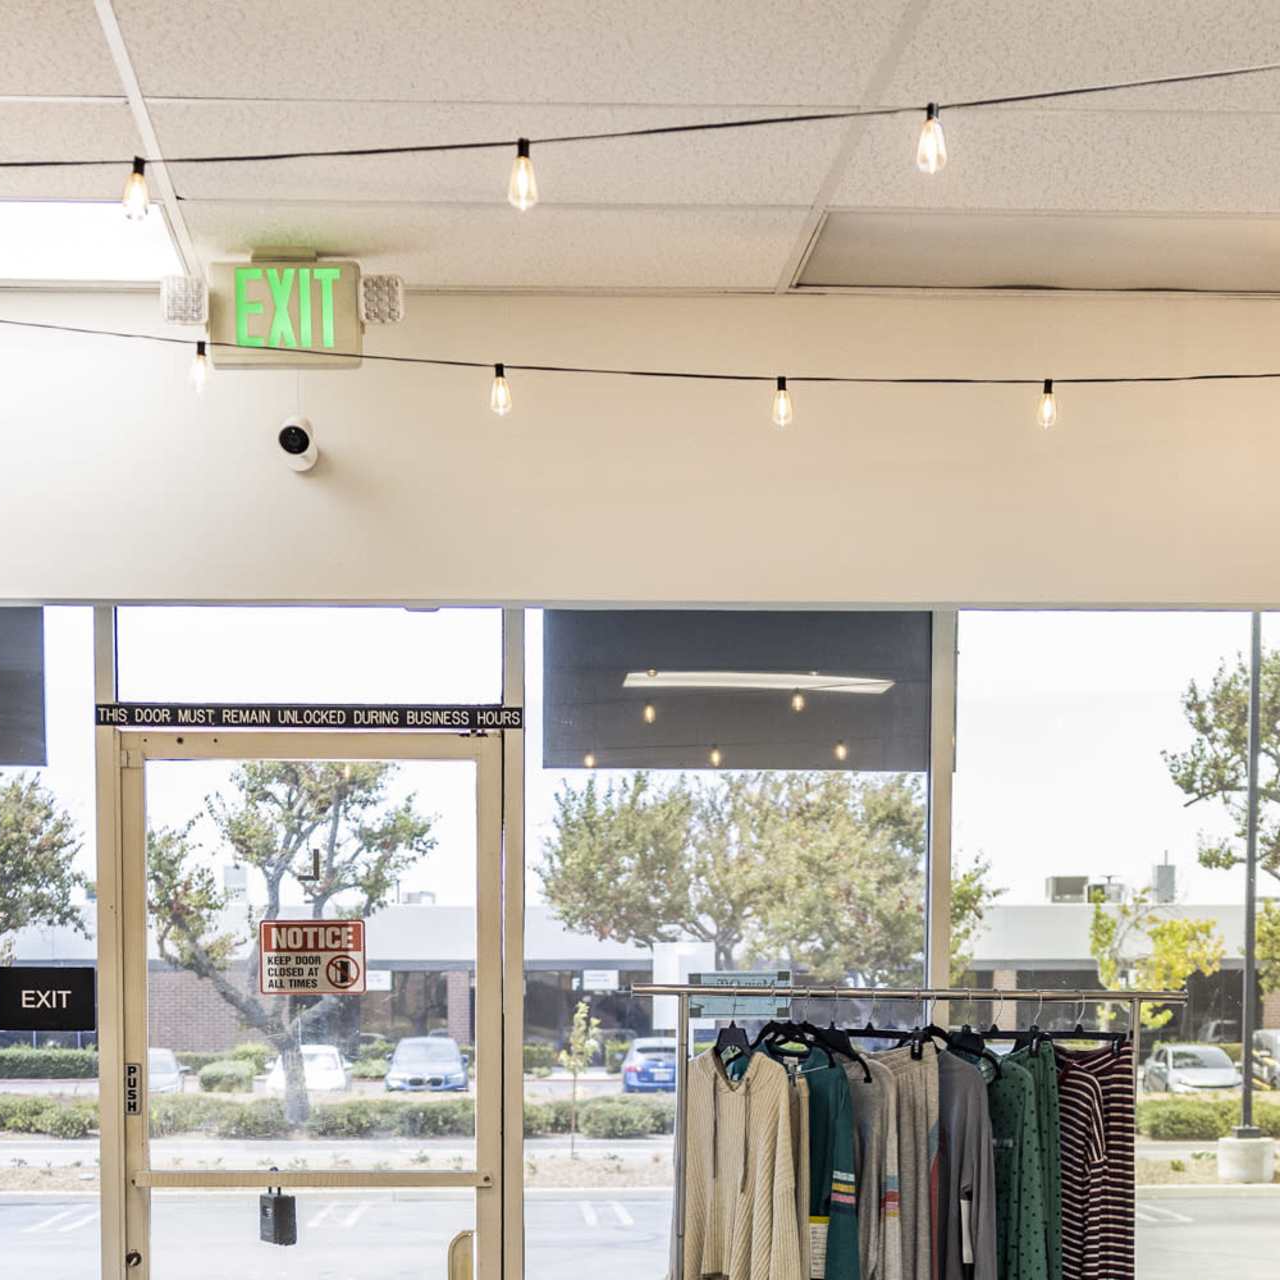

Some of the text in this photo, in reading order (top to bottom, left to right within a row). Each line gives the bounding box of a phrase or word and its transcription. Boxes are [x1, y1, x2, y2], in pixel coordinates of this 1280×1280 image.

[235, 267, 341, 348] EXIT
[98, 707, 520, 725] THIS DOOR MUST REMAIN UNLOCKED DURING BUSINESS HOURS
[271, 927, 353, 949] NOTICE
[267, 956, 321, 965] KEEP DOOR
[267, 967, 319, 977] CLOSED AT
[268, 979, 318, 989] ALL TIMES
[21, 990, 72, 1009] EXIT
[127, 1066, 137, 1112] PUSH
